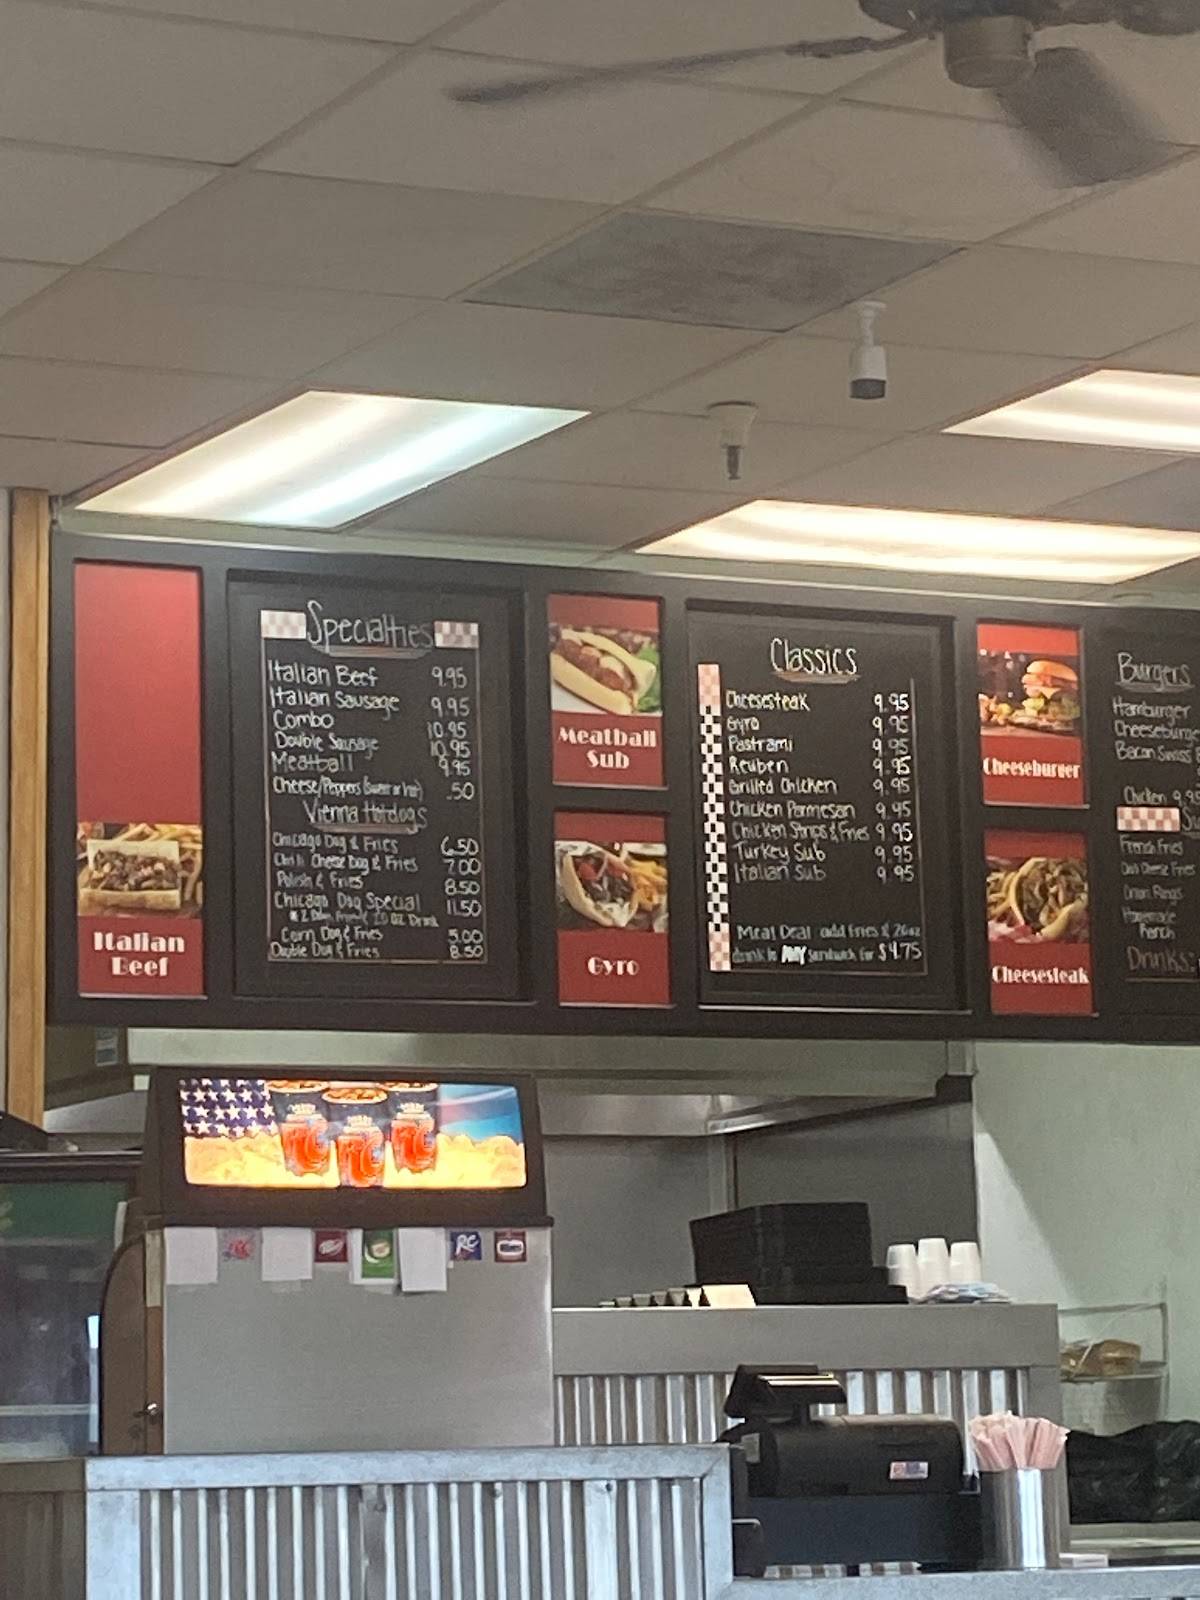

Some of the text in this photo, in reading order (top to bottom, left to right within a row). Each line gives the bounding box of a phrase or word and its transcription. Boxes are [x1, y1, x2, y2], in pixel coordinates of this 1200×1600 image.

[306, 600, 435, 654] Specialties
[770, 637, 858, 675] Classics
[268, 660, 467, 688] Italian Beef 9.95
[1117, 651, 1191, 692] Burgers
[270, 687, 470, 720] Italian Sausage 9.95
[726, 690, 910, 713] Cheesesteak 9.95
[1112, 696, 1192, 727] Hamburger
[273, 710, 466, 739] Combo 10.95
[727, 715, 909, 736] Gyro 9.95
[275, 732, 471, 759] Double Sausage 10.95
[558, 727, 656, 769] Meatball Sub
[728, 735, 909, 757] Pastrami 9.95
[1115, 740, 1155, 760] Bacon
[272, 751, 471, 776] Meatball 9.95
[729, 755, 911, 776] Reuben 9.95
[983, 757, 1080, 779] Cheeseburger
[446, 782, 475, 800] .50
[729, 776, 911, 797] Grilled Chicken 9.95
[1124, 785, 1167, 805] Chicken
[303, 799, 358, 824] Vienna
[730, 800, 911, 821] Chicken Parmesan 9.95
[732, 821, 786, 841] Chicken
[875, 822, 913, 842] 9.95
[272, 832, 321, 852] Chicago
[324, 836, 347, 852] Dog
[363, 837, 398, 853] Fries
[441, 836, 479, 856] 6.50
[734, 842, 912, 866] Turkey Sub 9.95
[1120, 834, 1183, 856] French Fries
[311, 854, 345, 869] Cheese
[348, 856, 369, 875] Dog
[385, 856, 419, 872] Fries
[443, 858, 482, 875] 7.00
[734, 864, 914, 885] Italian Sub 9.95
[277, 870, 313, 888] Polish
[330, 873, 364, 889] Fries
[444, 879, 480, 896] 8.50
[274, 891, 482, 918] Chicago Dog Special 11.50
[281, 926, 315, 943] Corn
[320, 926, 342, 945] Dog
[354, 927, 384, 941] Fries
[448, 929, 483, 944] 5.00
[737, 925, 776, 941] Meal
[780, 924, 812, 940] Deal
[94, 932, 185, 977] Italian Beef
[450, 945, 484, 960] 8.50
[1127, 946, 1195, 973] Drinks:
[587, 956, 639, 976] Gyro
[992, 966, 1089, 984] Cheesesteak
[455, 1234, 480, 1255] RC
